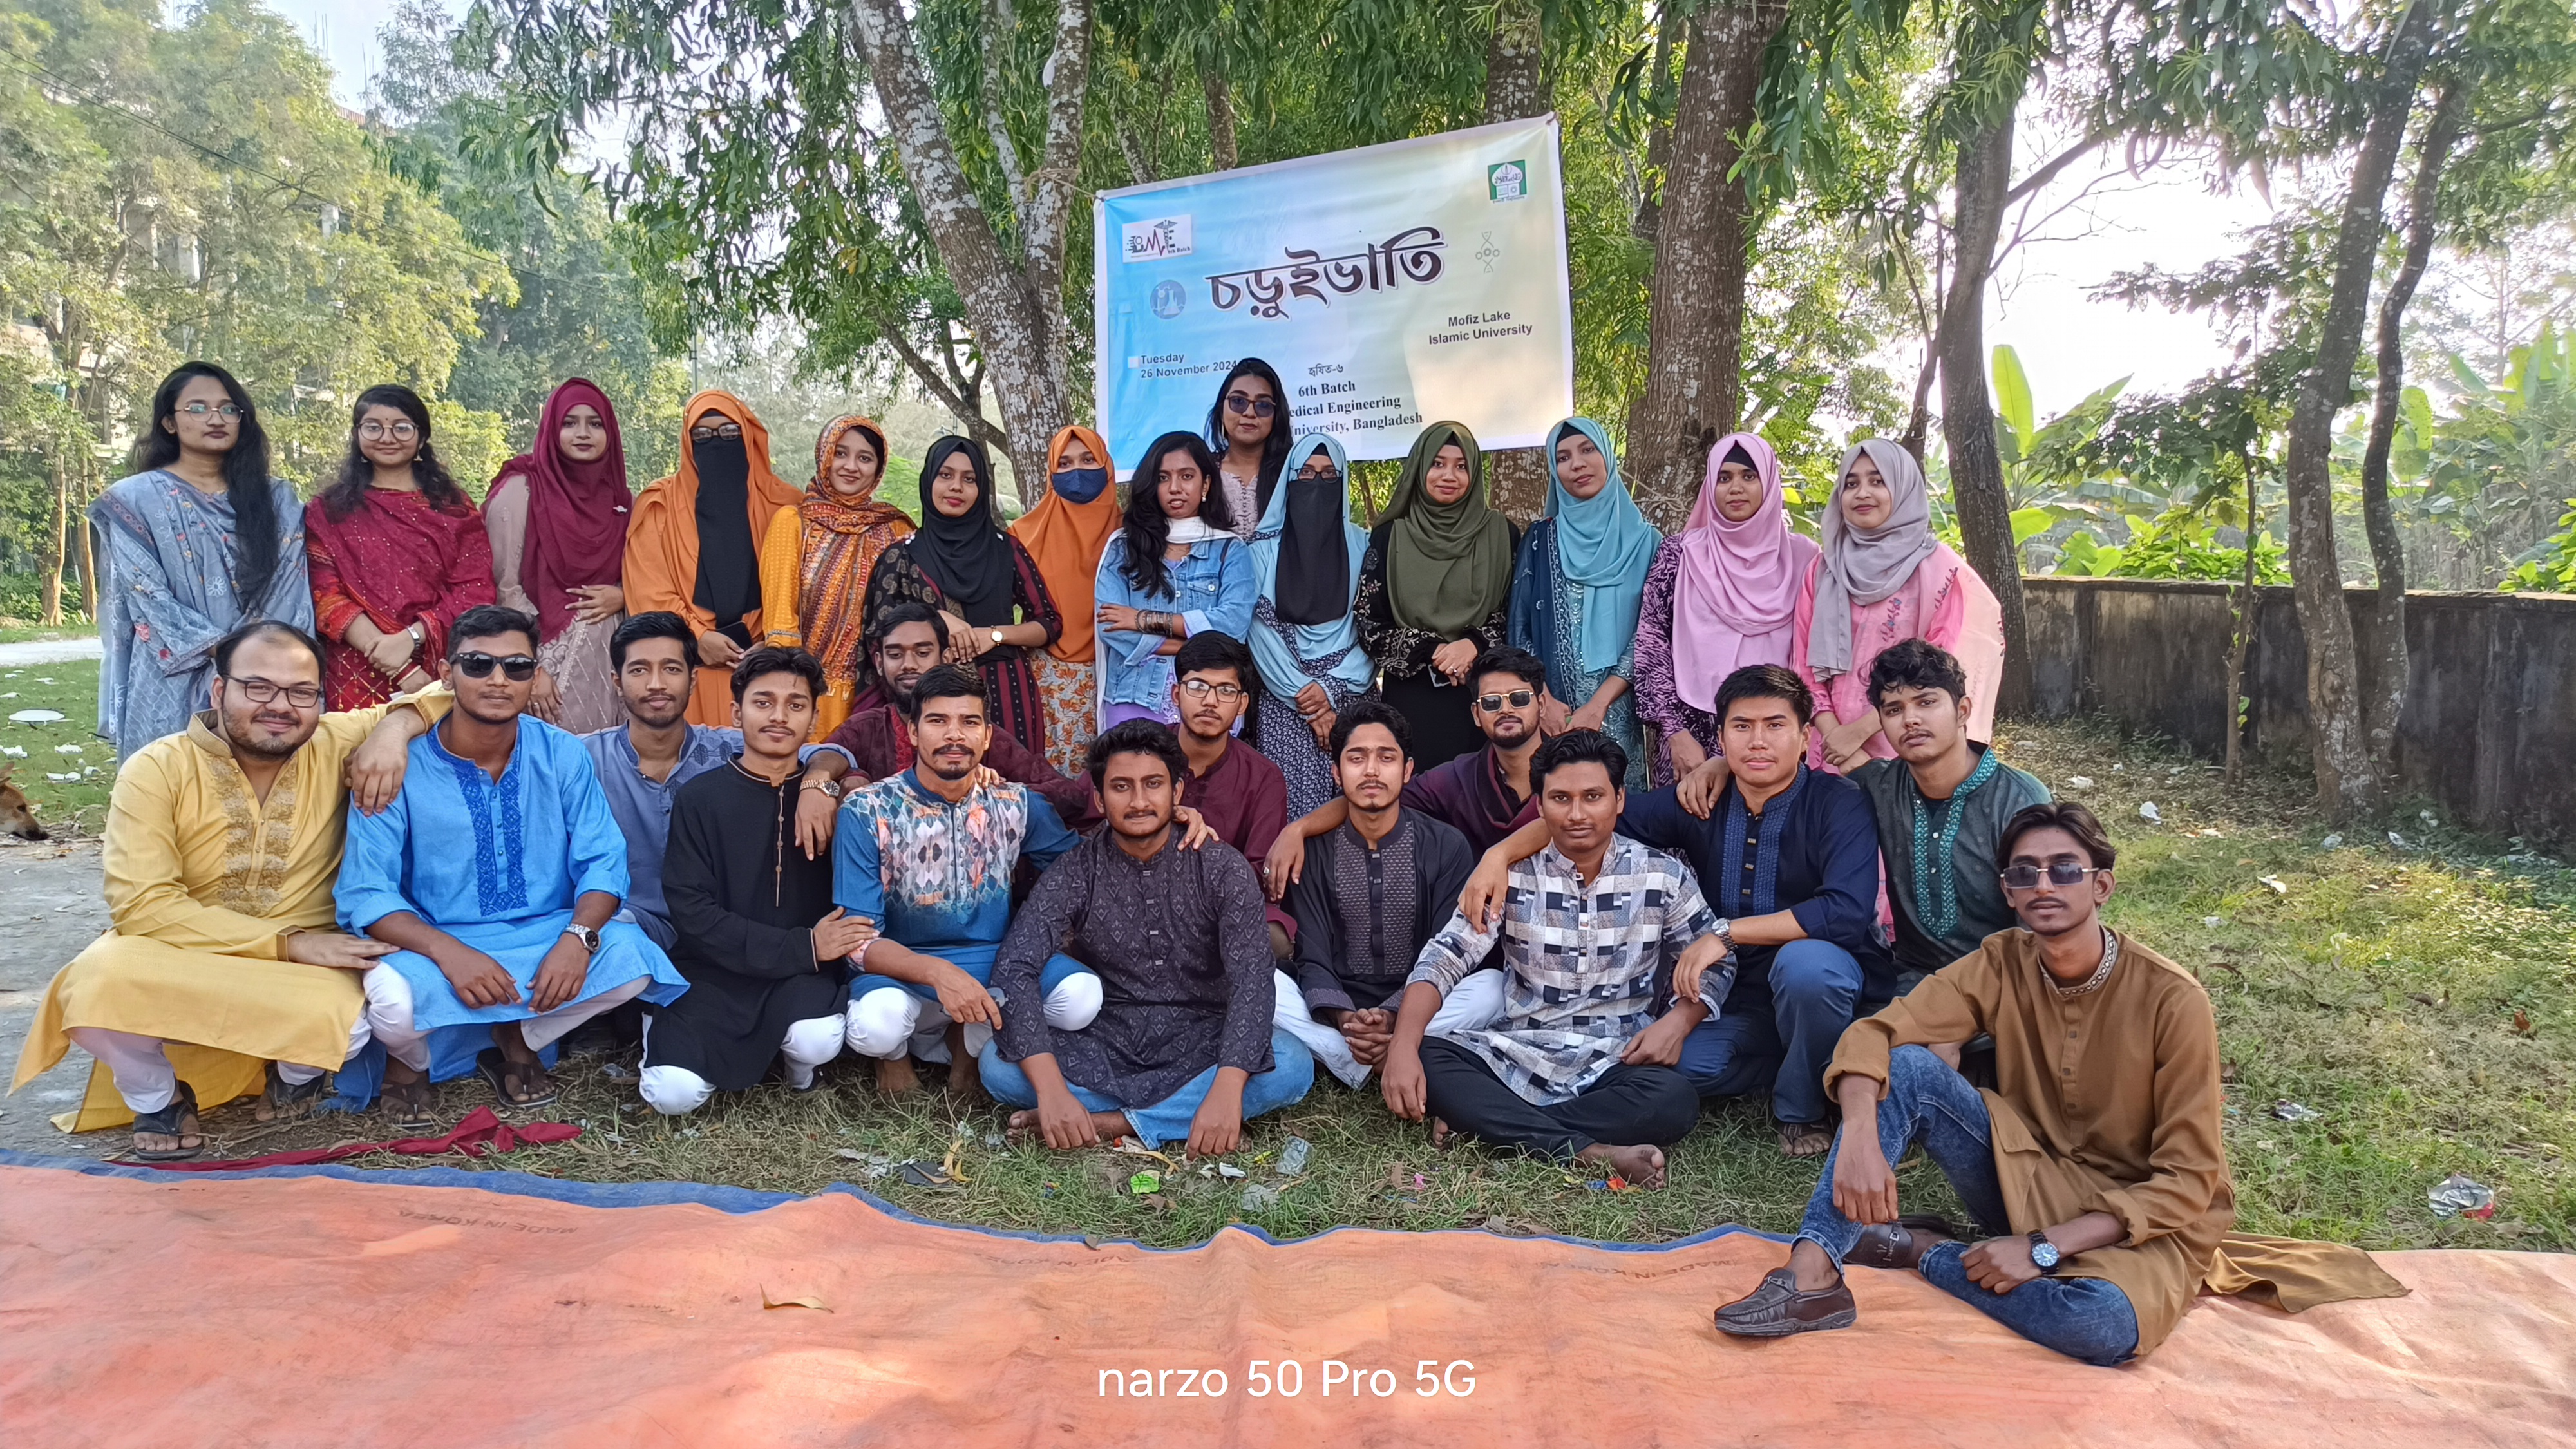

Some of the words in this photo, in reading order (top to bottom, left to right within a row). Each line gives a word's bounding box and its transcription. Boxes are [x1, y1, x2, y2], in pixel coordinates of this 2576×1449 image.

[1205, 226, 1444, 319] চড়ুইভাতি
[1448, 314, 1479, 327] Mofiz
[1482, 311, 1510, 323] Lake
[1429, 331, 1470, 345] Islamic
[1473, 324, 1532, 339] University
[1141, 354, 1184, 365] Tuesday
[1141, 369, 1153, 378] 26
[1156, 365, 1210, 377] November
[1213, 360, 1238, 372] 2024
[1298, 385, 1317, 397] 6th
[1321, 381, 1356, 395] Batch
[1289, 403, 1323, 417] edical
[1328, 396, 1401, 414] Engineering
[1291, 421, 1349, 434] niversity,
[1353, 412, 1423, 430] Bangladesh
[485, 1220, 507, 1229] IN
[513, 1222, 578, 1234] MADE
